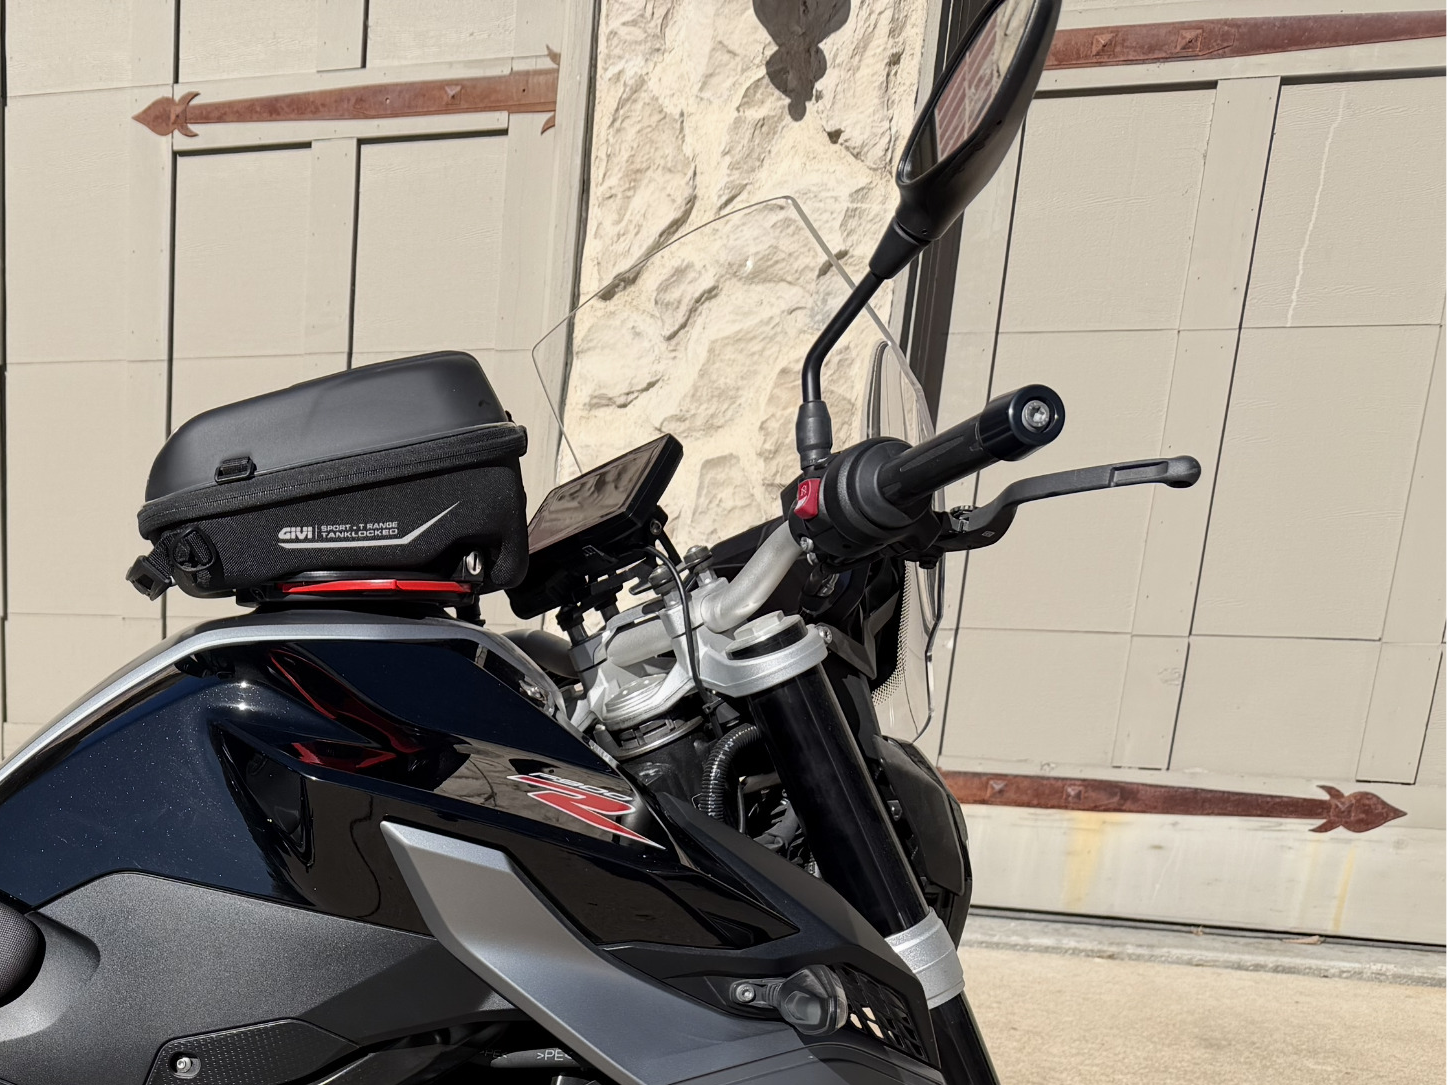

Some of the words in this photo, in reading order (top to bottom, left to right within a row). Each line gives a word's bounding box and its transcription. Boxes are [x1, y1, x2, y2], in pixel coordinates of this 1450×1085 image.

[278, 526, 313, 540] GIVI
[366, 521, 398, 529] RANGE
[320, 529, 398, 539] TANKLOCKED
